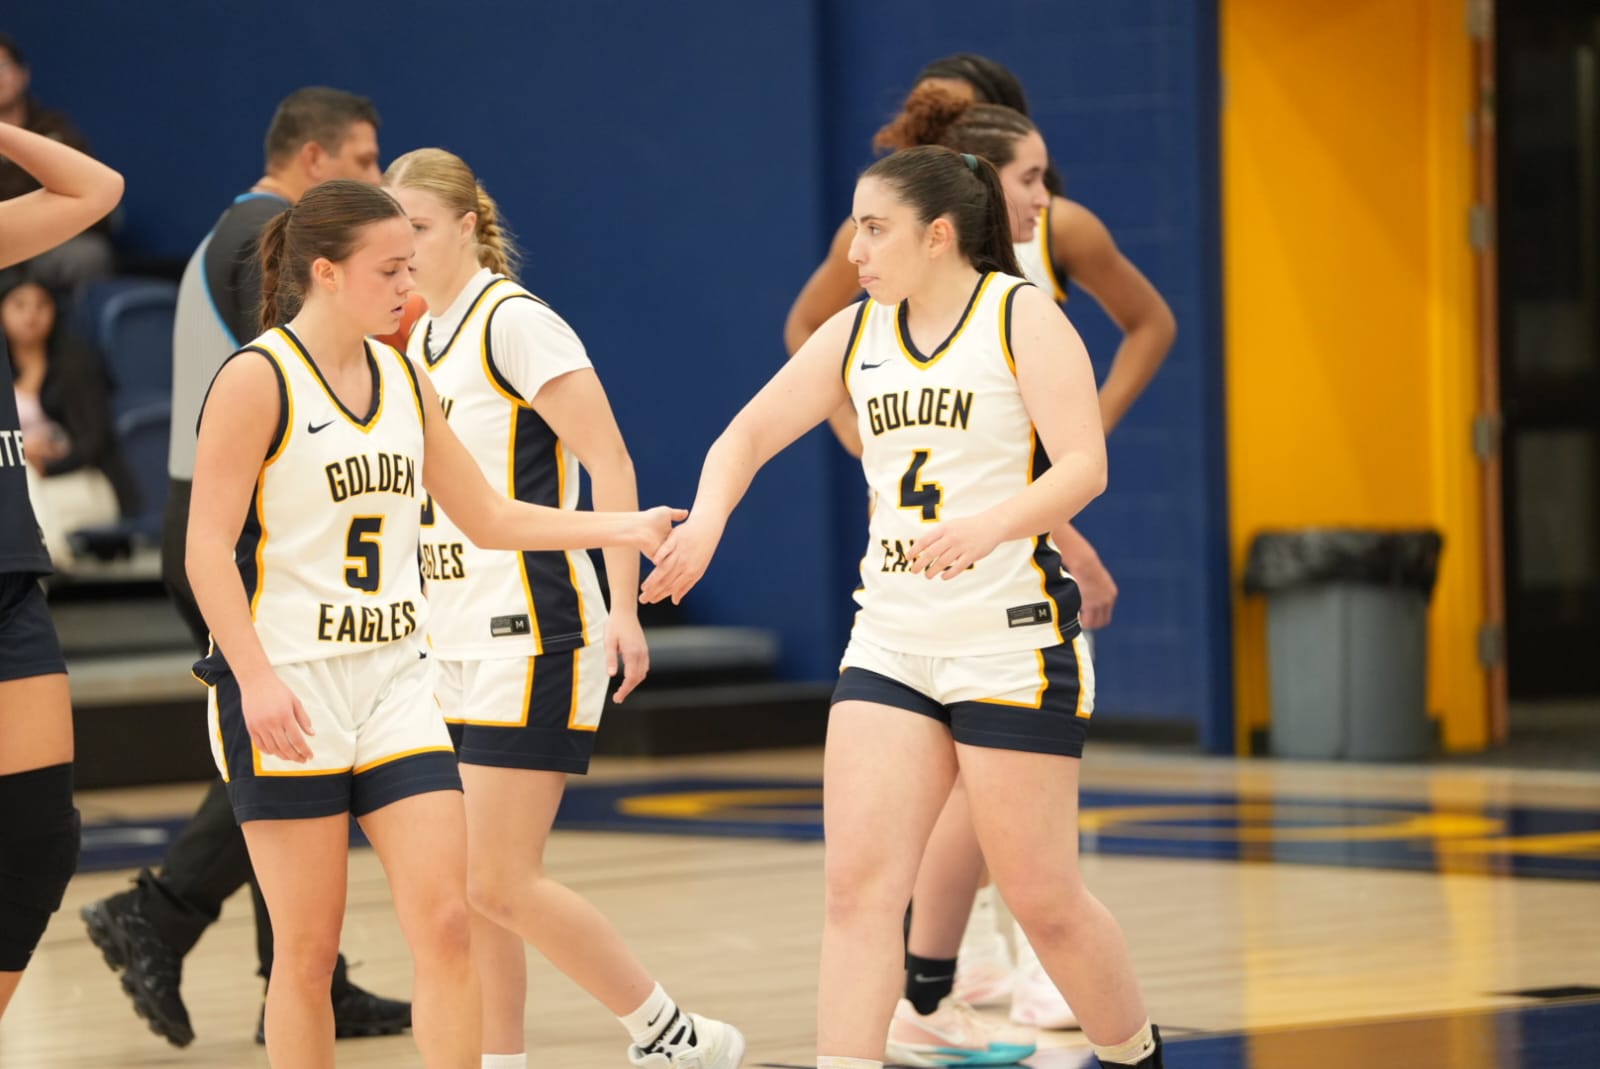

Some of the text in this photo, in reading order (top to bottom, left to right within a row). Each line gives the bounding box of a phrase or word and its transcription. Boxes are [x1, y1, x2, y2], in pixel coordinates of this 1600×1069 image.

[867, 387, 974, 436] GOLDEN
[0, 430, 26, 467] TE
[325, 452, 414, 502] GOLDEN
[897, 448, 943, 523] 4
[344, 514, 385, 594] 5
[422, 543, 466, 581] GLES
[318, 600, 416, 643] EAGLES
